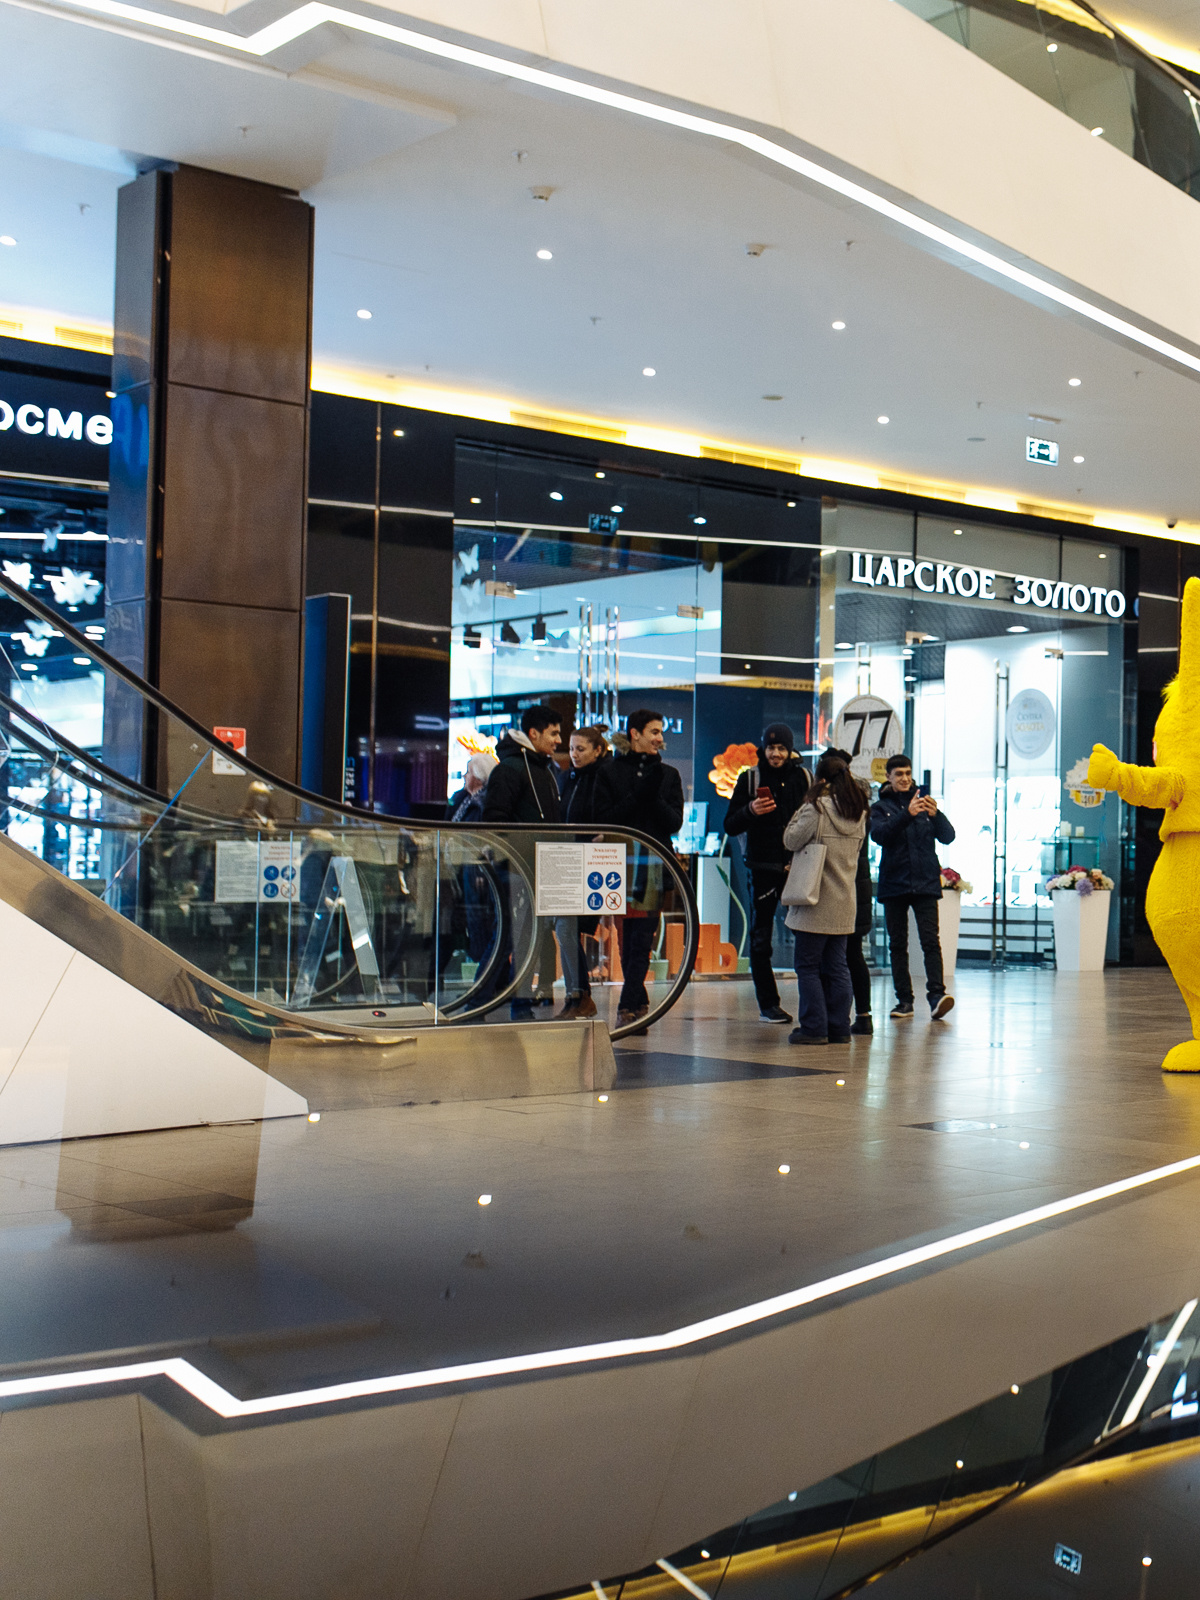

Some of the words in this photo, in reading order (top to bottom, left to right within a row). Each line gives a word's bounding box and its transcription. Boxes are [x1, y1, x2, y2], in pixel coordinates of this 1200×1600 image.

[851, 552, 996, 600] ЦАРСКОЕ
[1013, 575, 1126, 618] ЗОЛОТО
[843, 710, 893, 757] 77
